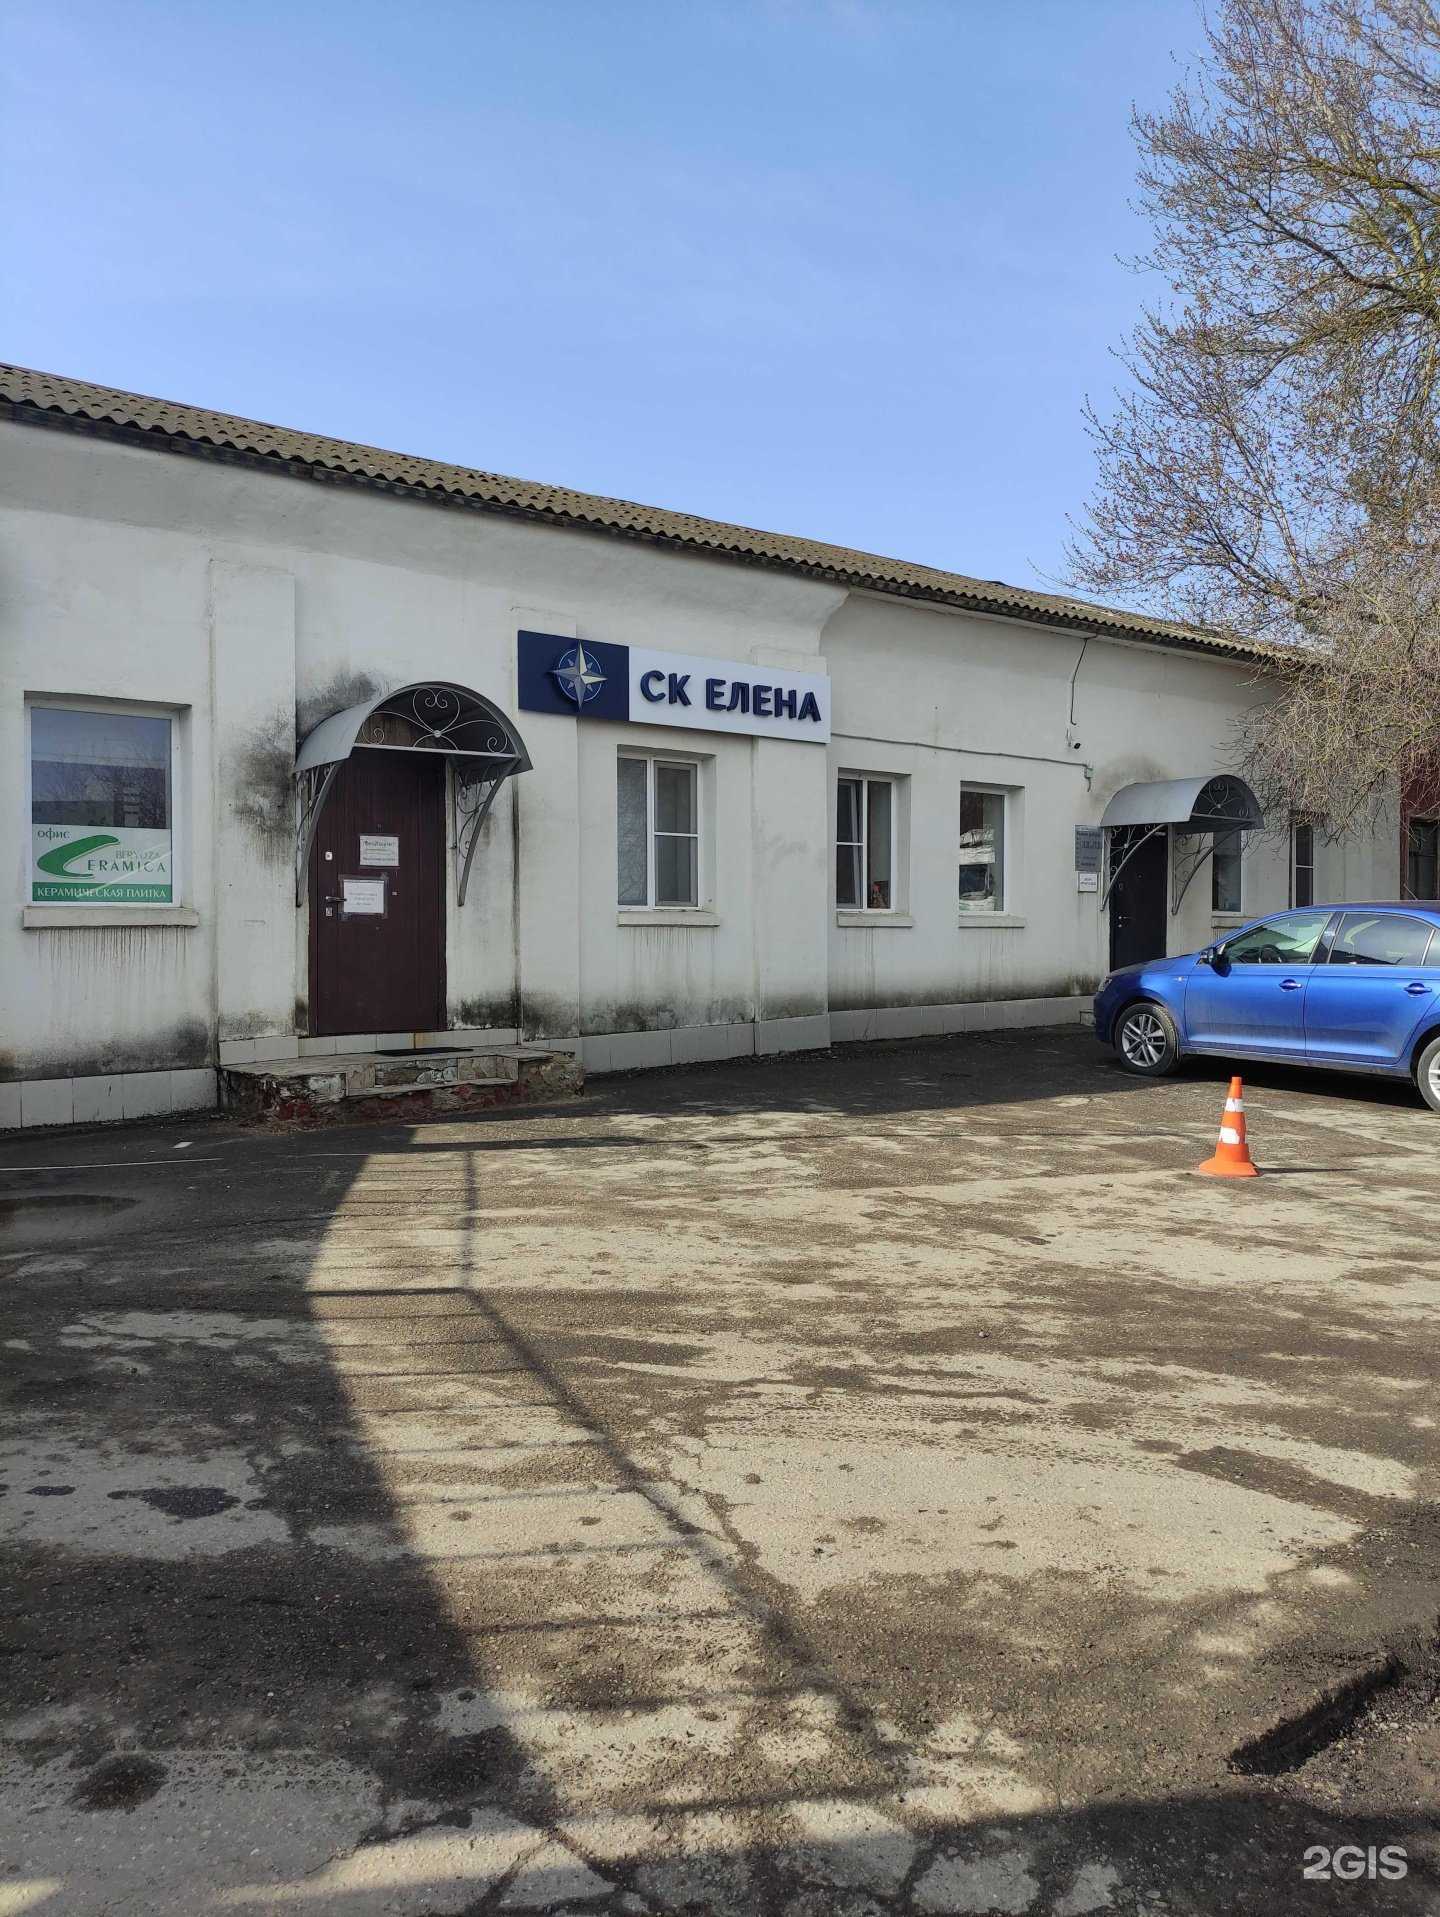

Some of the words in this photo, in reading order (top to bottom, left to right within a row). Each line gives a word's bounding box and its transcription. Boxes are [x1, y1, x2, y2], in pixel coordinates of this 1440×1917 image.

[640, 669, 692, 706] СК
[705, 678, 822, 722] ЕЛЕНА
[37, 827, 70, 841] офис
[37, 886, 123, 899] КЕРАМИЧЕСКАЯ
[126, 888, 166, 899] ПЛИТКА
